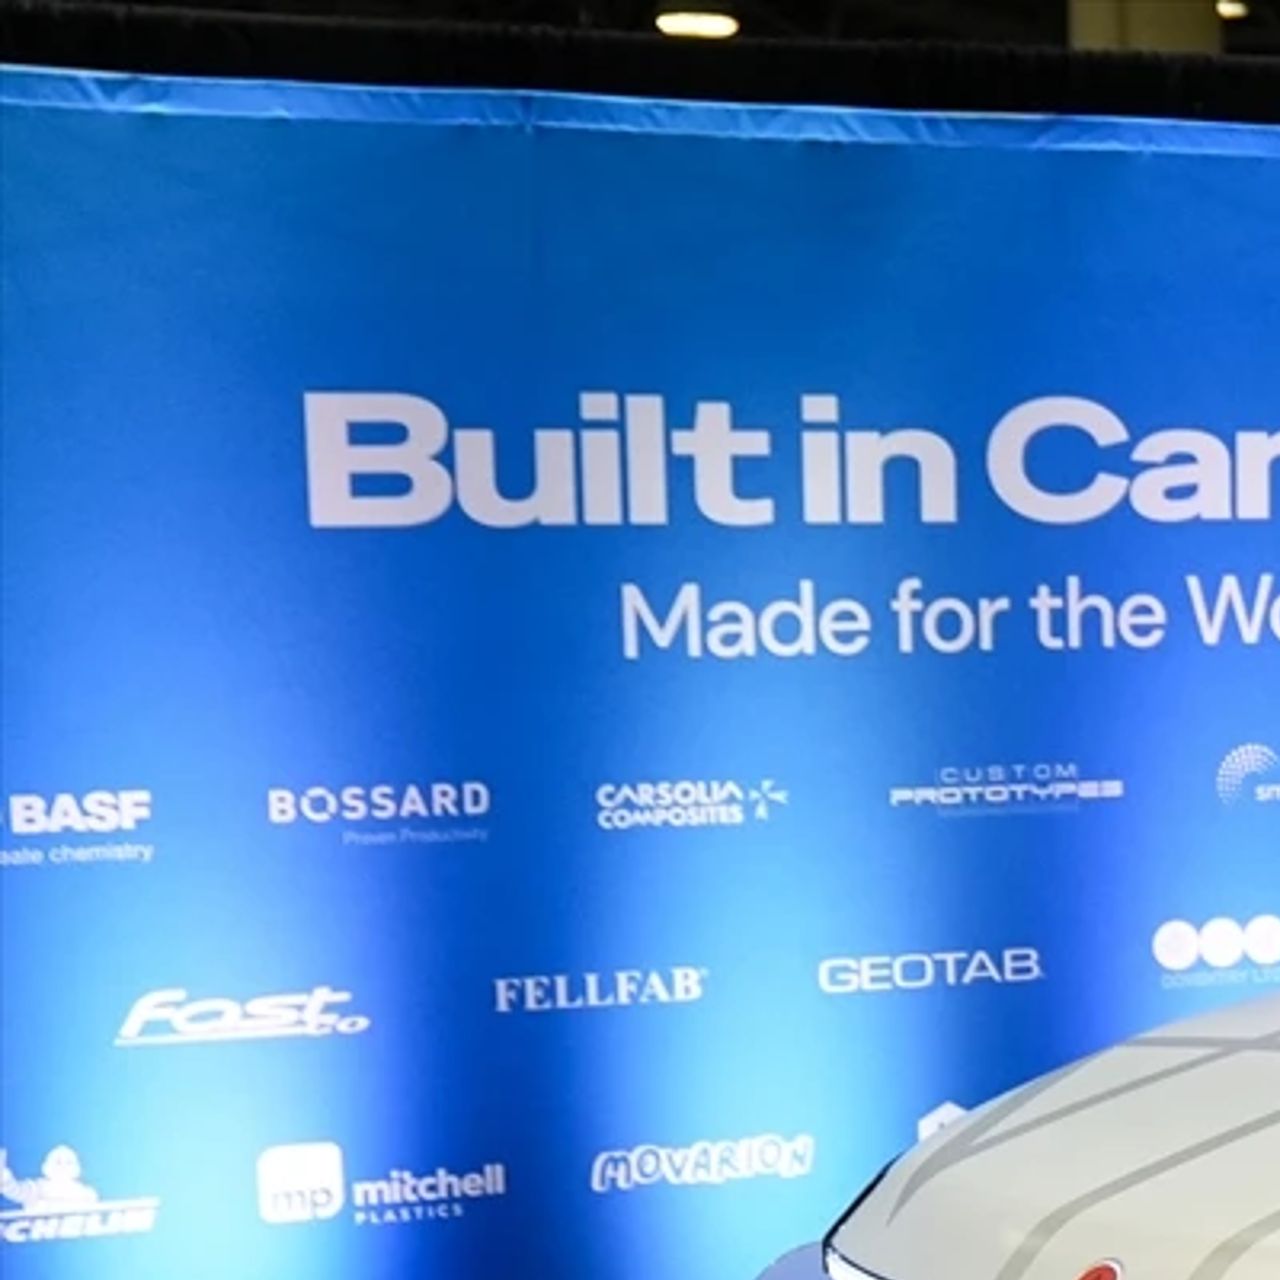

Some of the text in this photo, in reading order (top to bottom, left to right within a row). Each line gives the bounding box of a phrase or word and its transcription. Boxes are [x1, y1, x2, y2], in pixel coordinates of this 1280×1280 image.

[303, 391, 773, 529] Built
[802, 394, 958, 523] in
[620, 582, 871, 659] Made
[890, 579, 1000, 653] for
[1031, 575, 1165, 649] the
[889, 780, 1124, 806] PROTOTYPES
[939, 763, 1078, 783] CUSTOM
[9, 788, 152, 835] BASF
[267, 781, 491, 825] BOSSARD
[597, 804, 744, 830] COMPOSITES
[48, 843, 155, 866] chemistry
[494, 966, 704, 1013] FELLFAB
[817, 947, 1045, 994] GEOTAB
[352, 1163, 506, 1208] mitchell
[354, 1202, 464, 1225] PLASTICS
